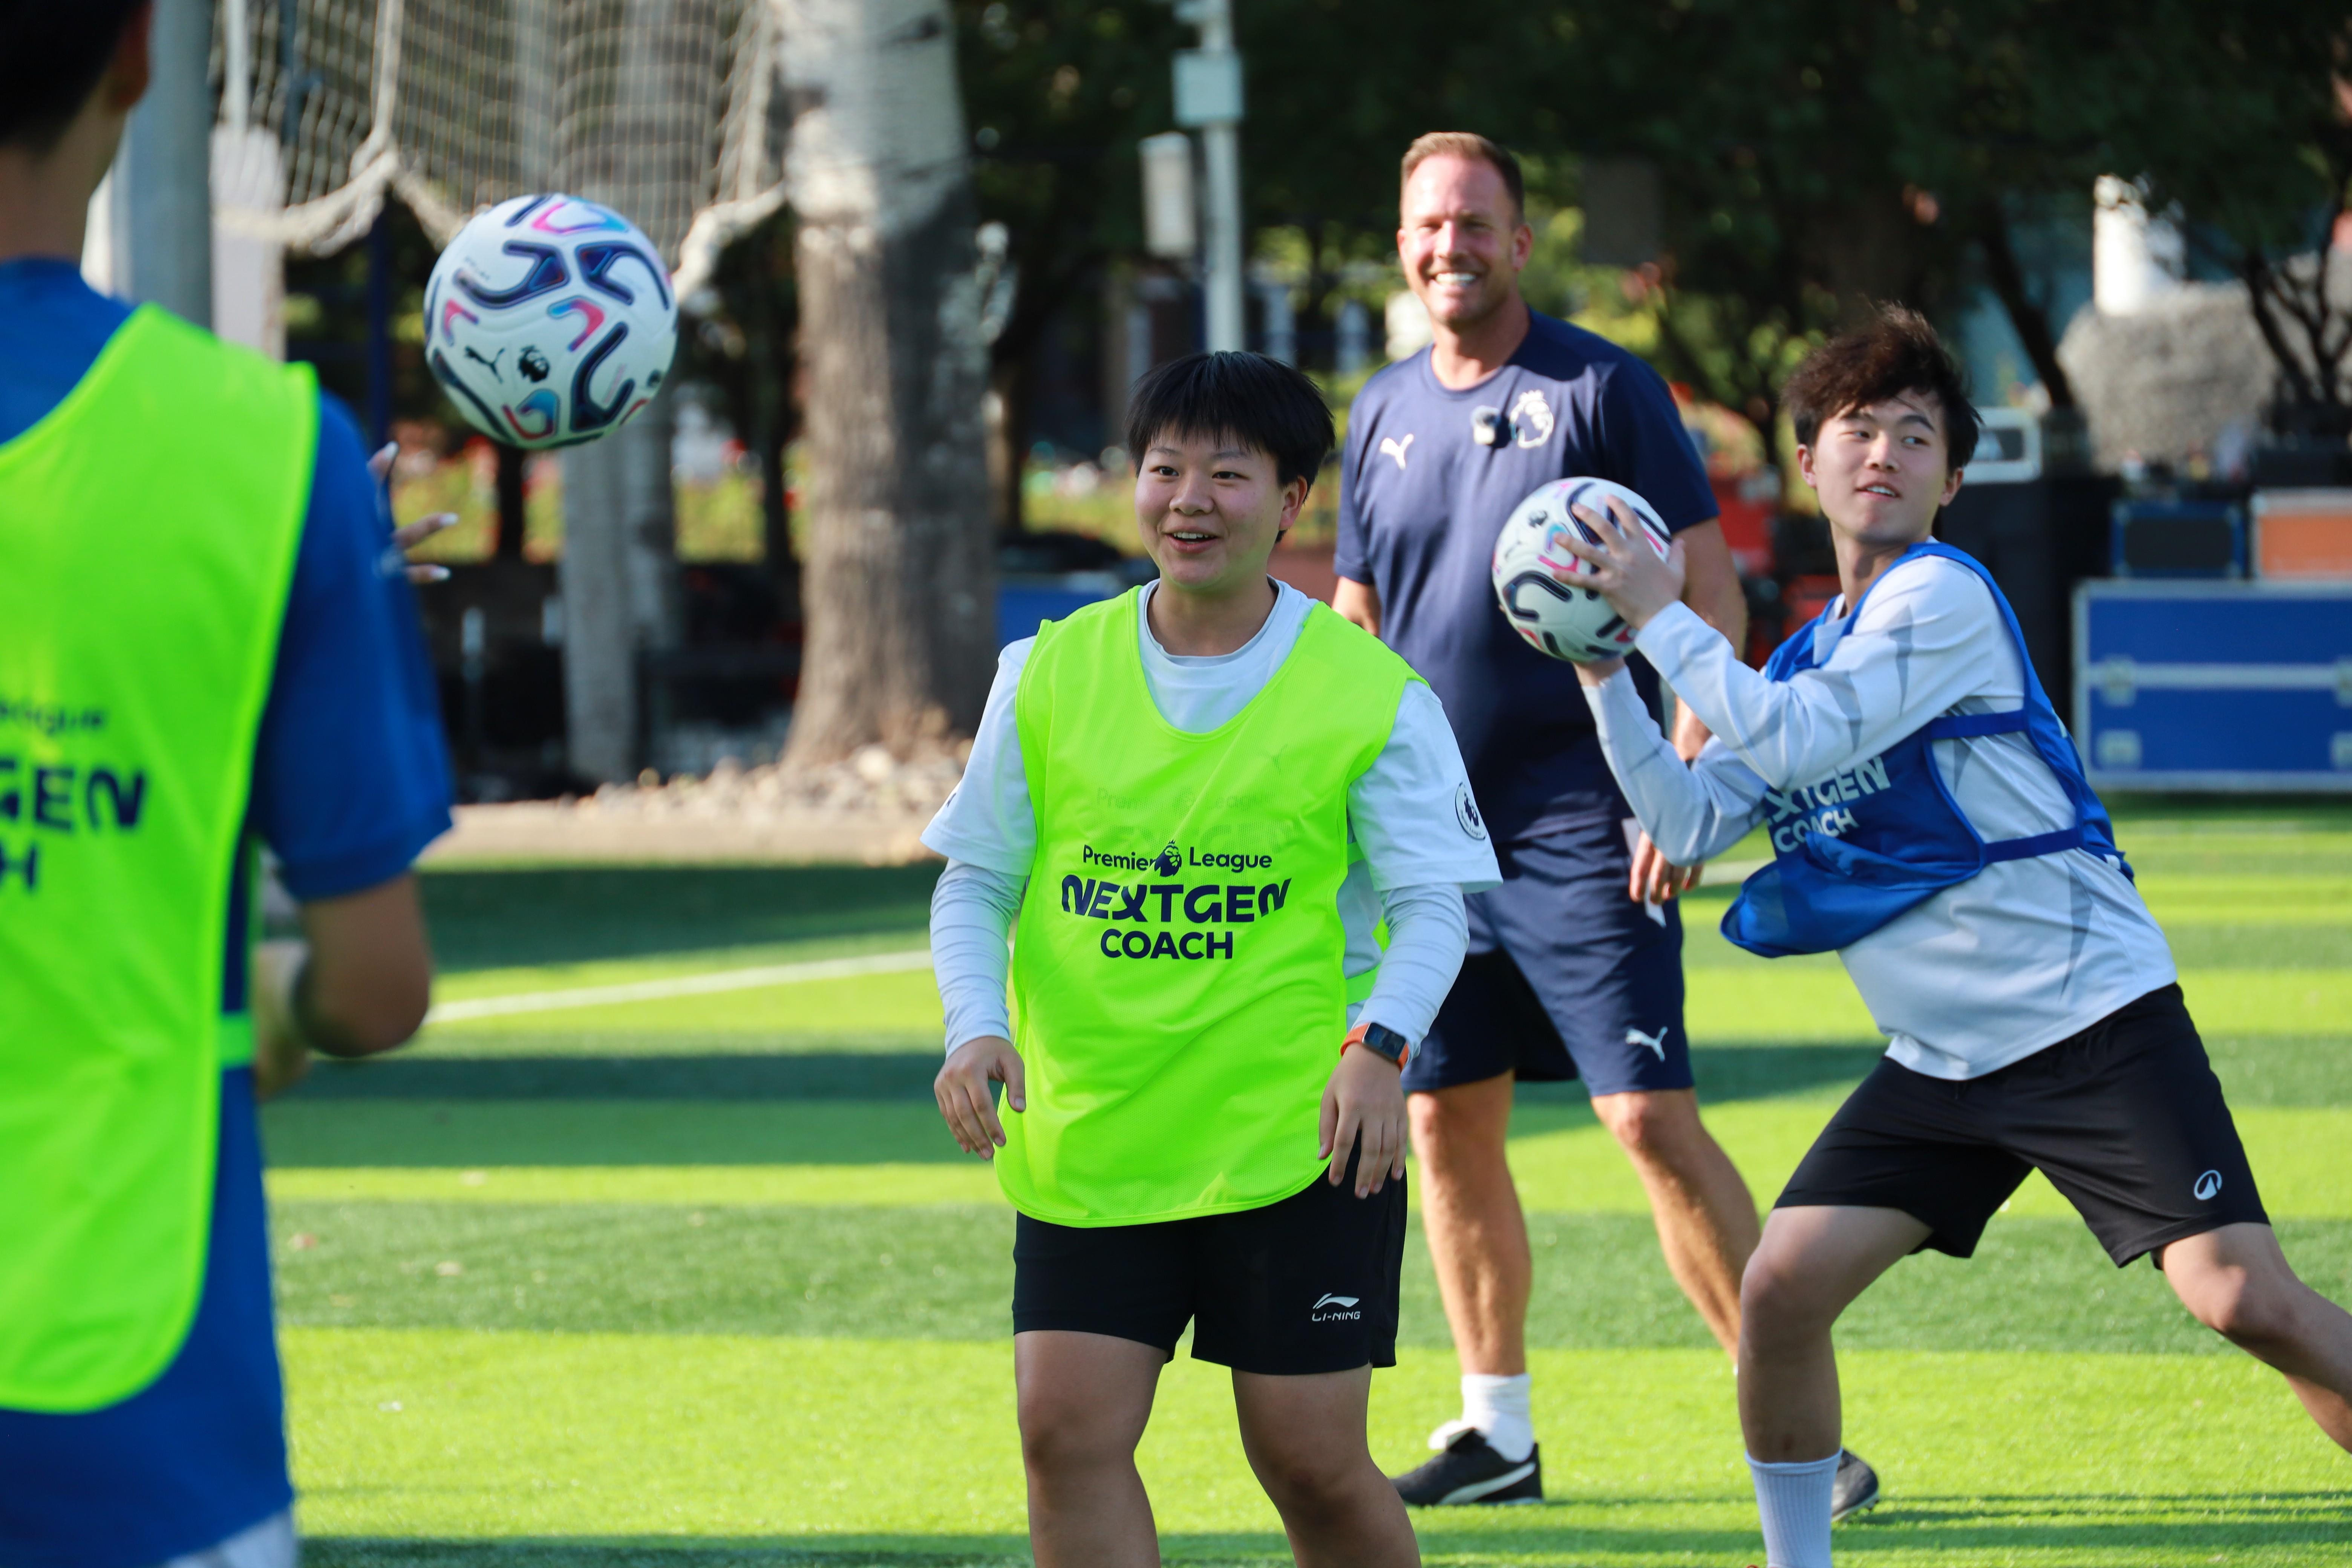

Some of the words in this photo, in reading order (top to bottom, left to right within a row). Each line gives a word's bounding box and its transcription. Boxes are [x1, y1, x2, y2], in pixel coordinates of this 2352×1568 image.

[1083, 845, 1156, 870] Premier
[1190, 847, 1272, 873] League
[1061, 874, 1292, 923] NEXTGEN
[1100, 929, 1233, 959] COACH
[1312, 1311, 1360, 1321] LI-NING
